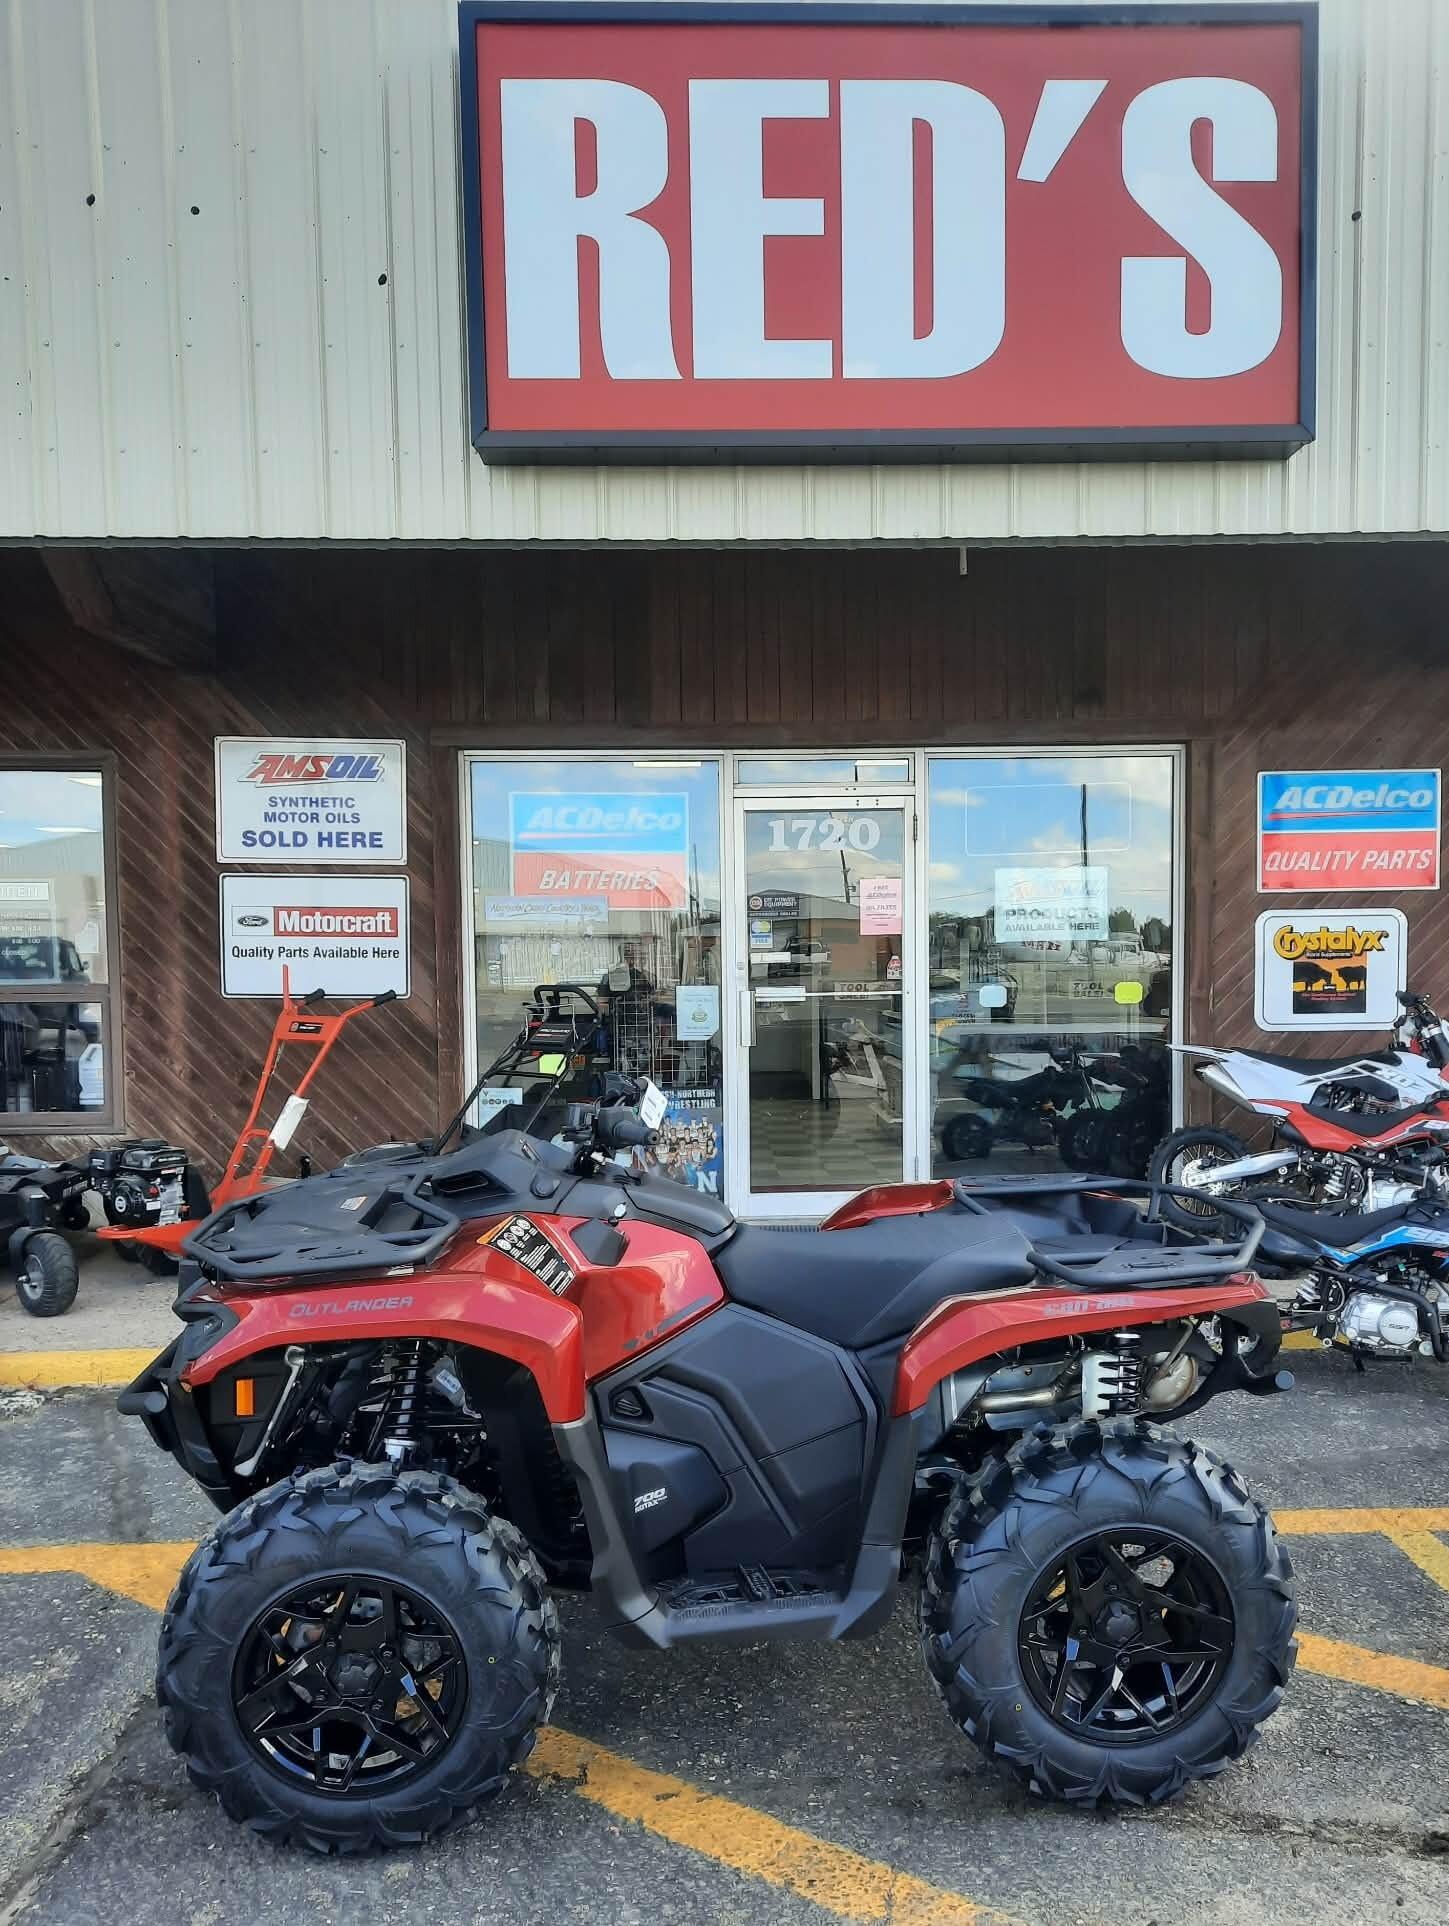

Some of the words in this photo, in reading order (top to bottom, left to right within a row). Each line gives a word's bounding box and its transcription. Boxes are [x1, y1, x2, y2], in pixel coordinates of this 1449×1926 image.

[500, 76, 1283, 380] RED'S
[246, 753, 384, 785] AMSOIL
[267, 796, 356, 809] SYNTHETIC
[1273, 783, 1433, 810] ACDelco
[263, 811, 320, 824] MOTOR
[325, 811, 361, 824] OILS
[527, 807, 682, 832] ACDelco
[241, 830, 308, 848] SOLD
[317, 831, 384, 849] HERE
[767, 817, 880, 852] 1720
[1265, 850, 1360, 872] QUALITY
[1361, 849, 1433, 870] PARTS
[538, 869, 658, 890] BATTERIES
[279, 911, 392, 934] Motorcraft
[1069, 922, 1100, 931] HERE
[231, 945, 274, 961] Quality
[278, 946, 309, 959] Parts
[313, 946, 368, 959] Available
[372, 947, 400, 959] Here
[1273, 924, 1384, 960] Crystalyx
[289, 1297, 413, 1317] OUTLANDER
[634, 1487, 666, 1507] 700
